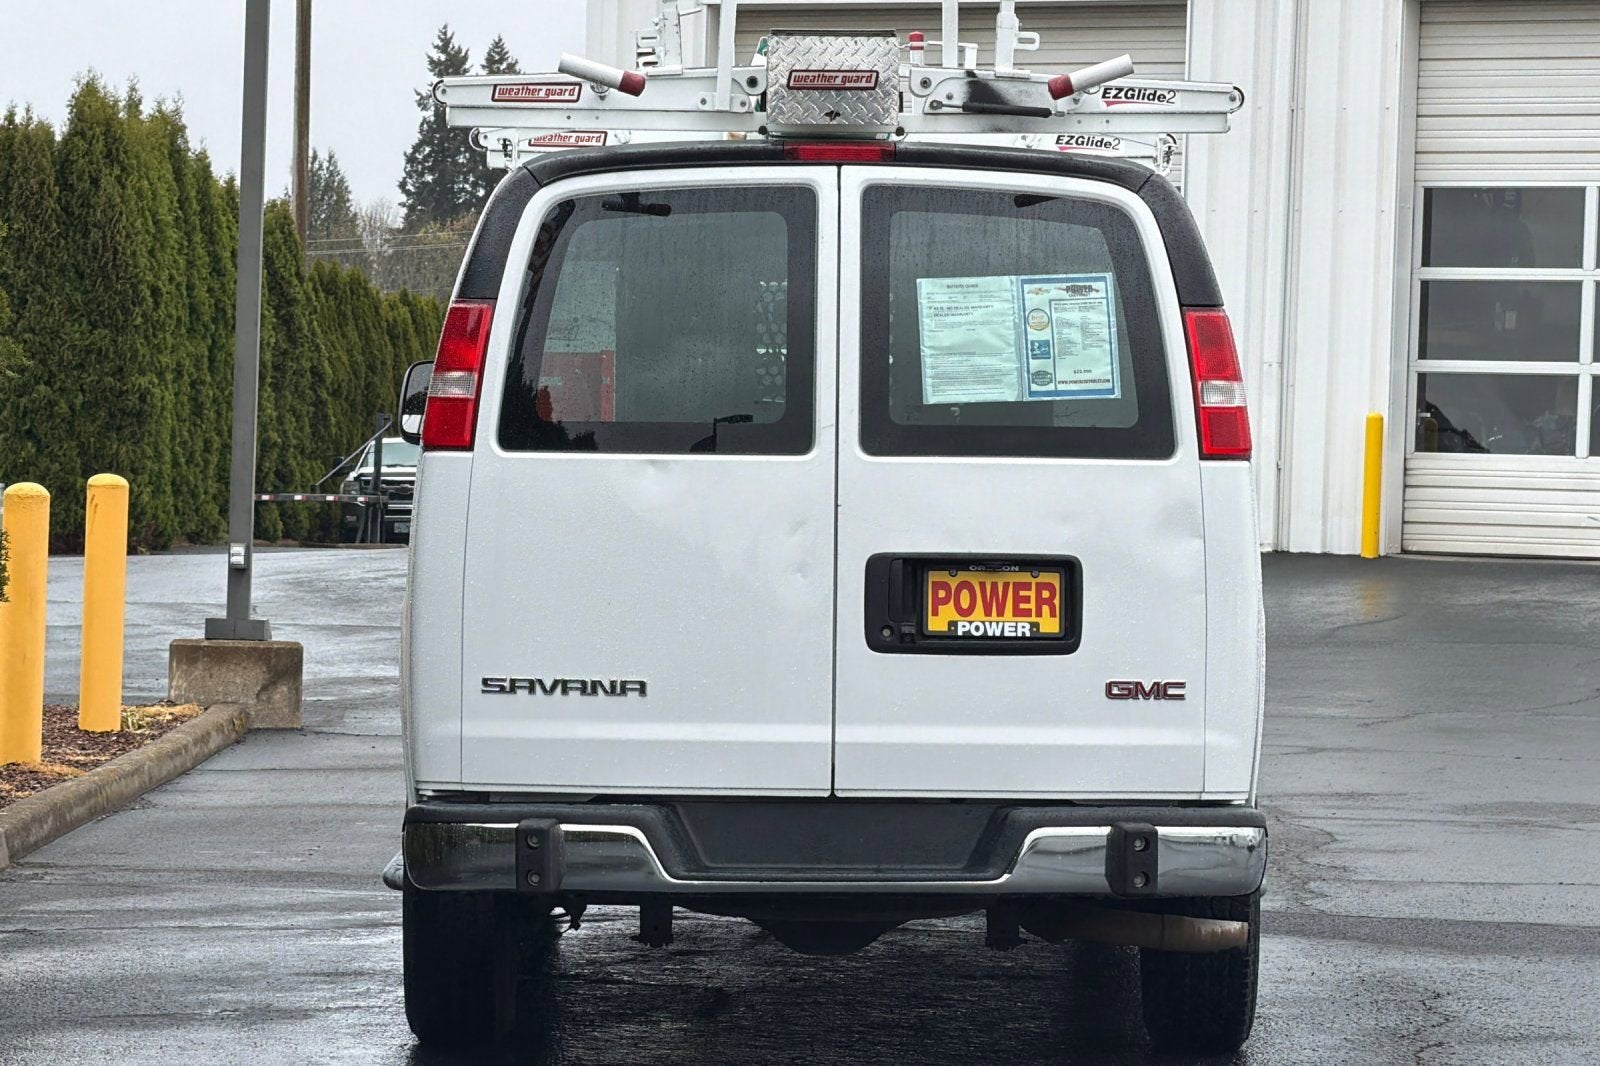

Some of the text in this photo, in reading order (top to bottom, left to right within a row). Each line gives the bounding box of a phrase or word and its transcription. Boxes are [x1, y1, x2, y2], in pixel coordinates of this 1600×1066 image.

[793, 73, 873, 86] weather guard
[497, 85, 576, 99] weather guard
[1101, 87, 1177, 104] EZGlide2
[574, 134, 602, 145] guard
[1055, 134, 1121, 151] EZGlide2
[931, 580, 1058, 618] POWER
[957, 621, 1031, 637] POWER
[481, 676, 648, 698] SAVANA
[1105, 679, 1186, 701] GMC
